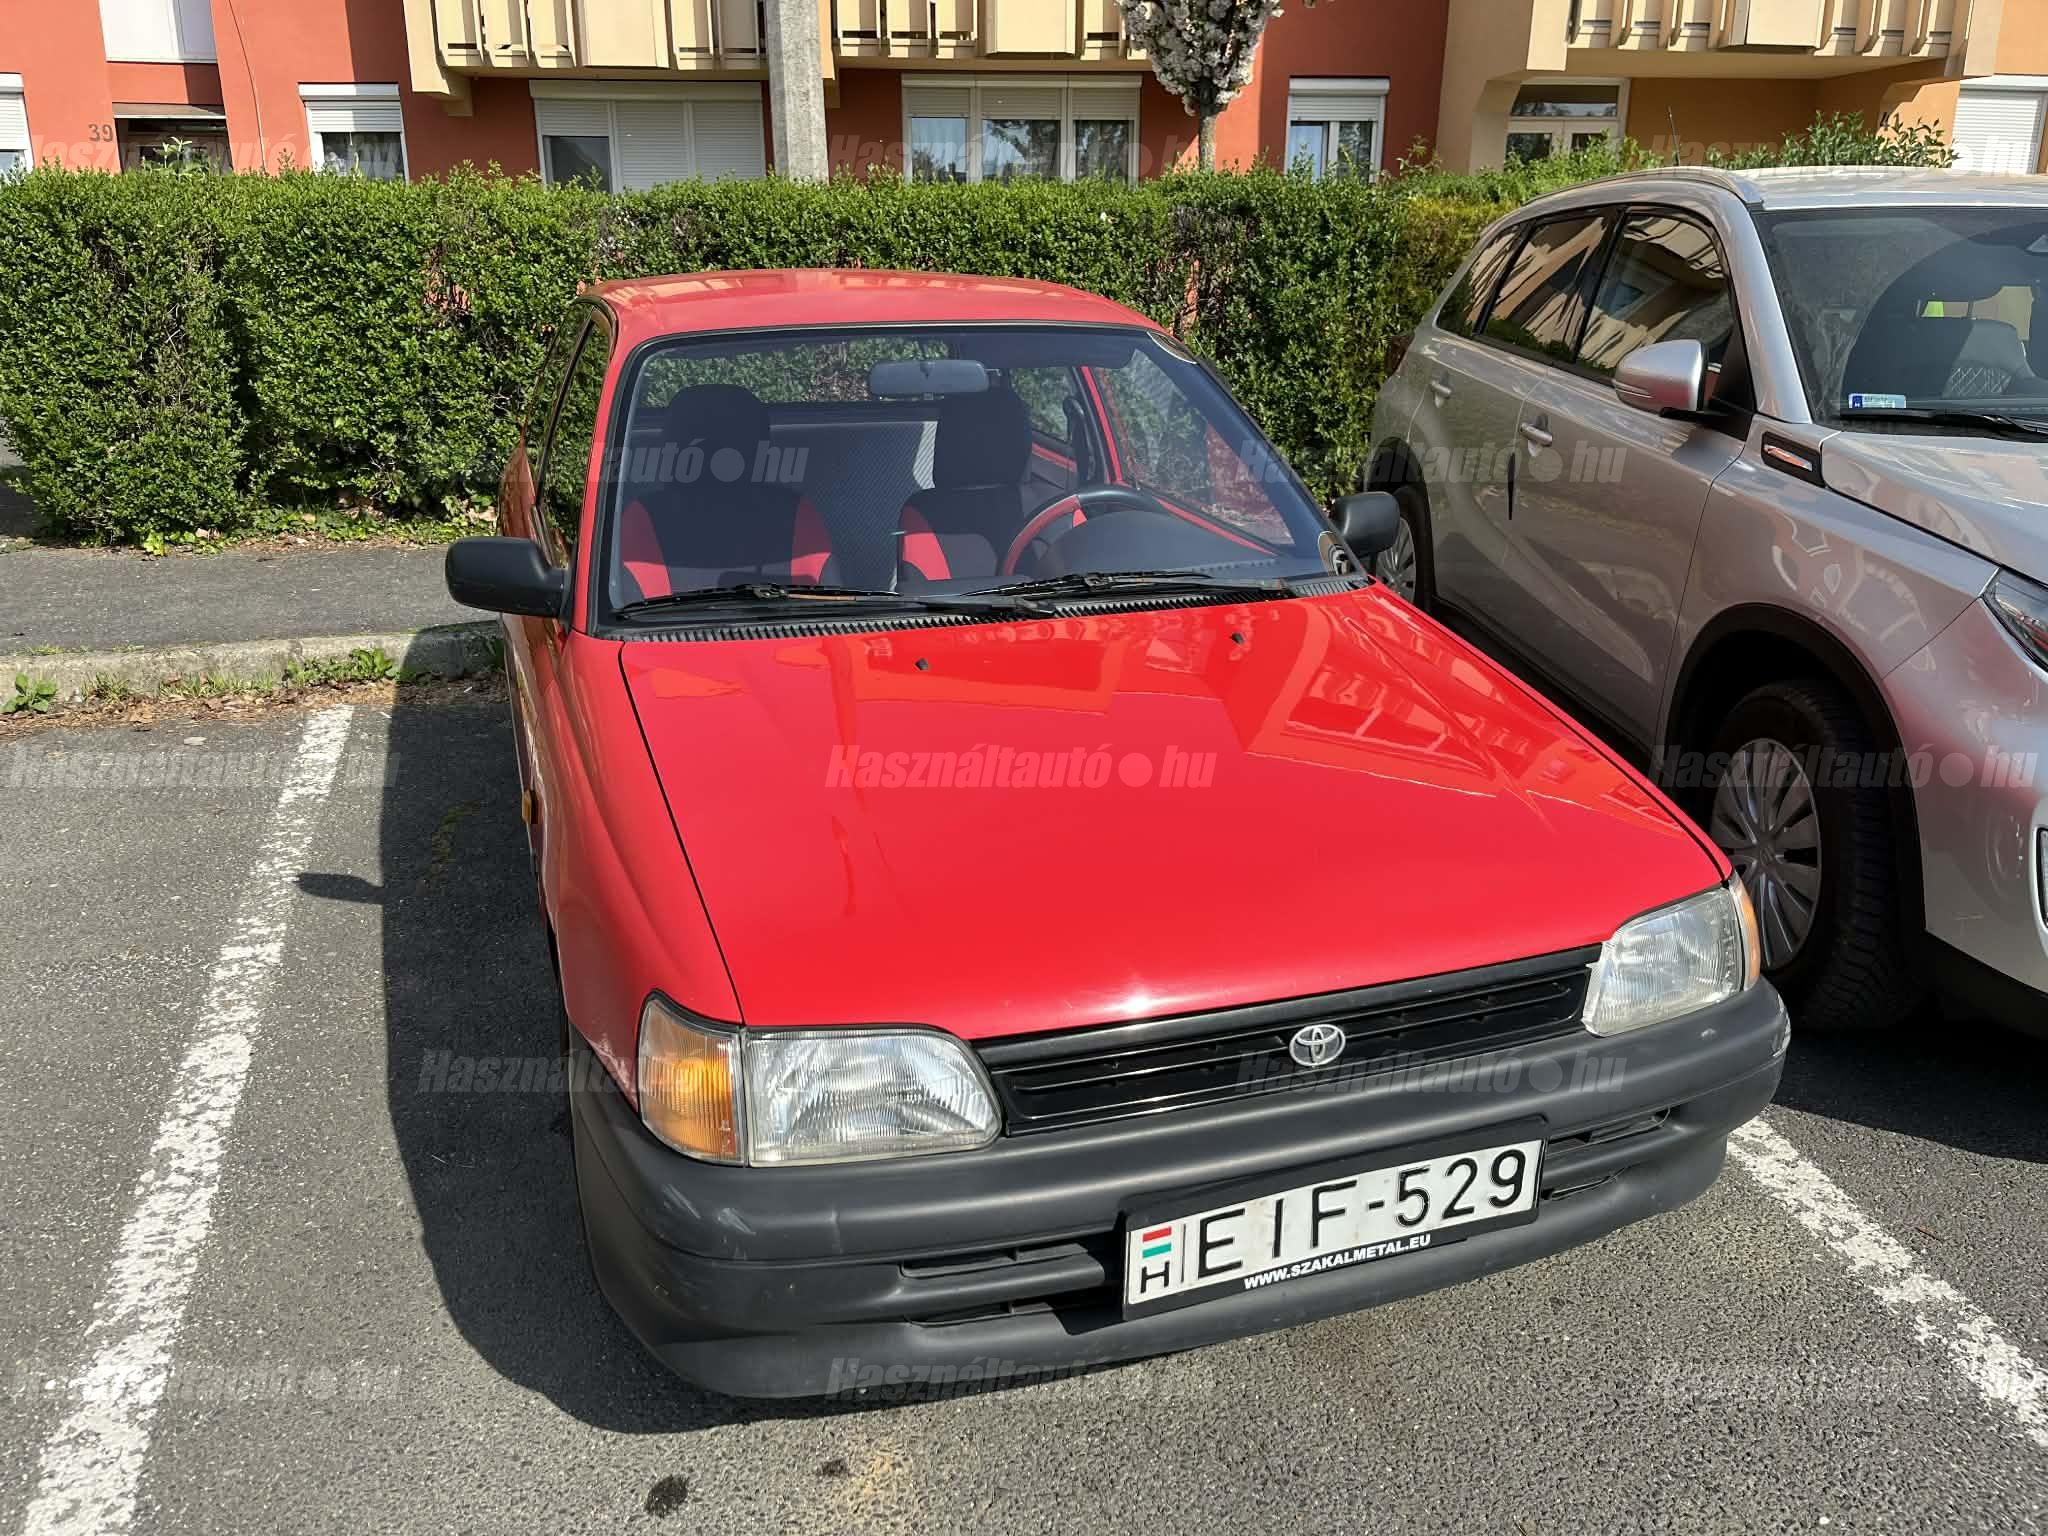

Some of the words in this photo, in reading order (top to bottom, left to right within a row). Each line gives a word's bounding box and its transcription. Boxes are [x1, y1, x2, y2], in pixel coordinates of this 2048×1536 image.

[88, 123, 114, 142] 39
[1140, 1261, 1170, 1293] H
[1198, 1149, 1527, 1279] EIF-529
